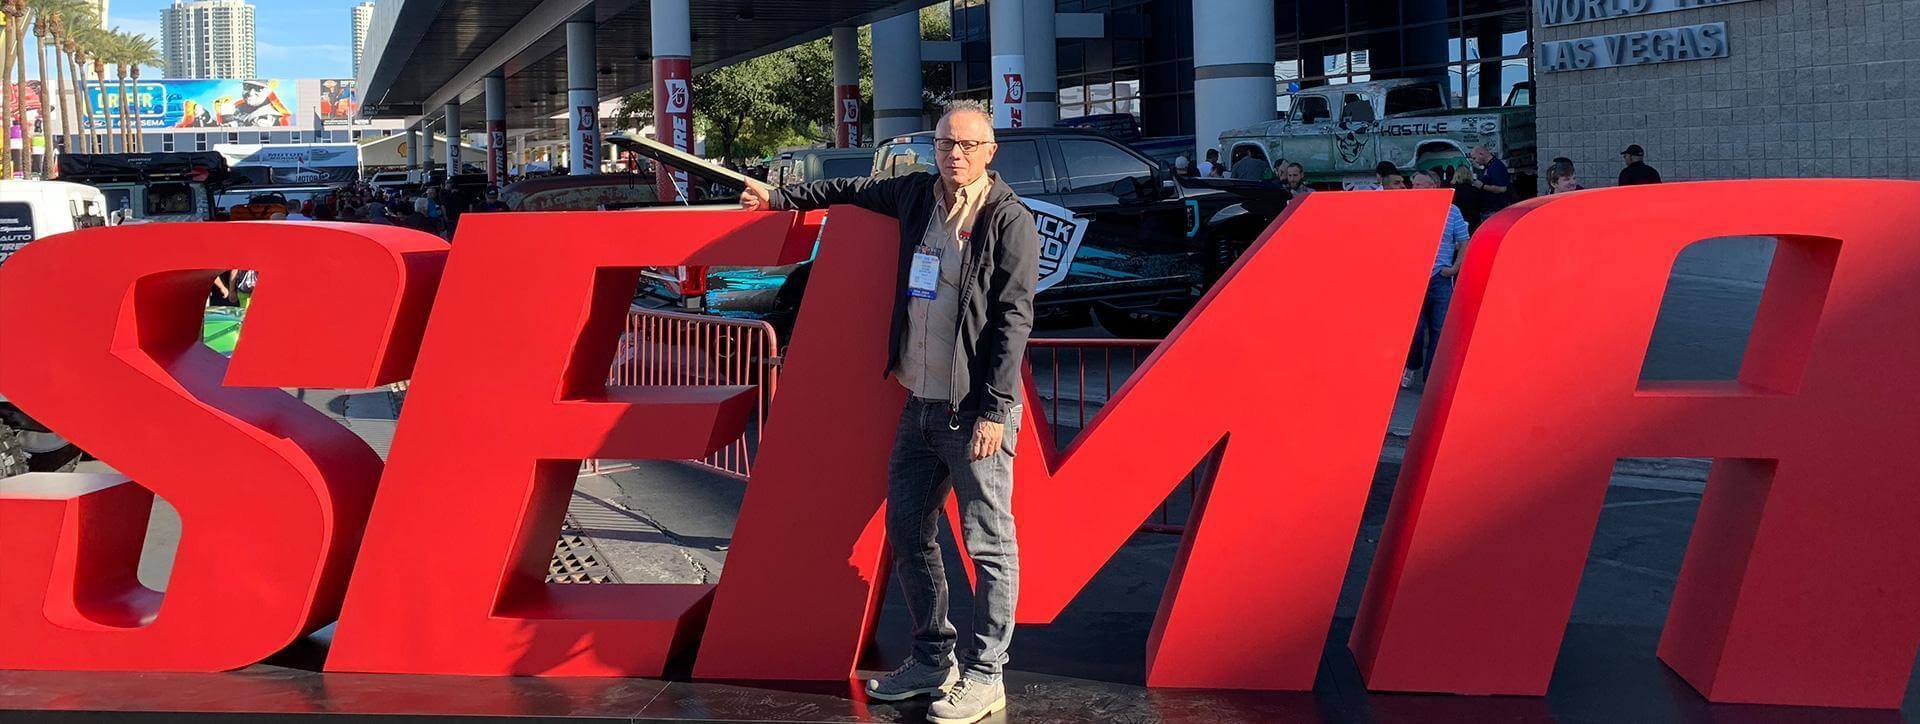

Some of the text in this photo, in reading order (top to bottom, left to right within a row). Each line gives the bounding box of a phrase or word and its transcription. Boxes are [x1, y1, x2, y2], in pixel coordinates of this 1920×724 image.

[1539, 24, 1722, 71] LAS VEGAS
[142, 119, 164, 127] SEMA
[1380, 122, 1448, 136] HOSTILE
[583, 132, 594, 169] TIRE
[0, 178, 1920, 708] SEMA
